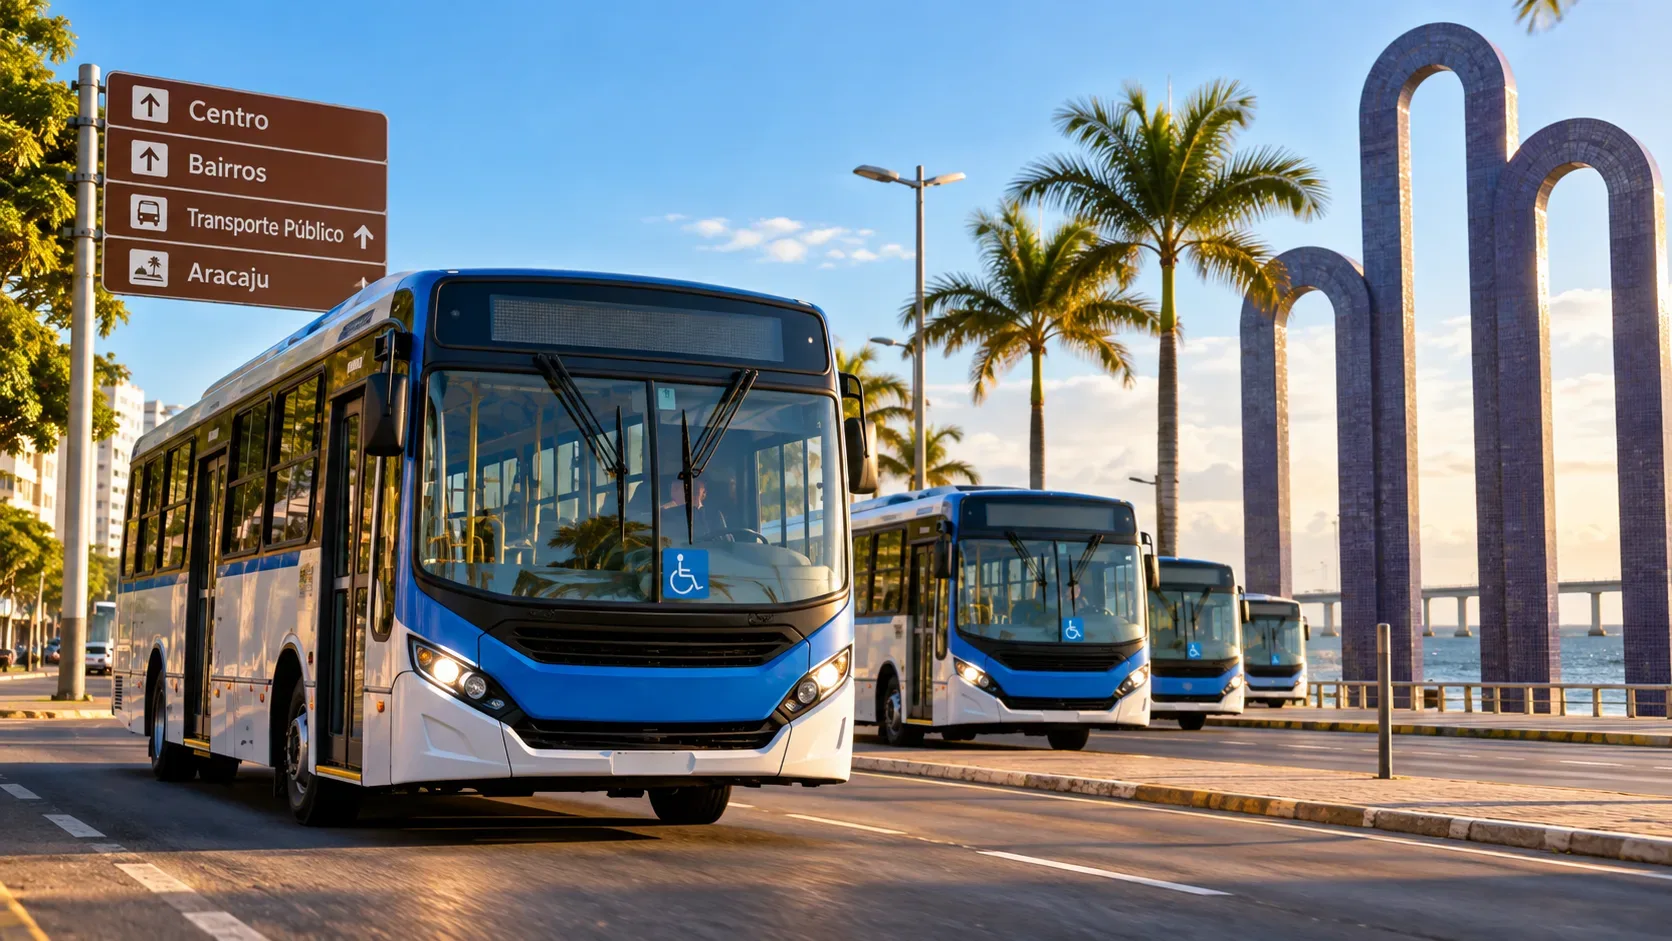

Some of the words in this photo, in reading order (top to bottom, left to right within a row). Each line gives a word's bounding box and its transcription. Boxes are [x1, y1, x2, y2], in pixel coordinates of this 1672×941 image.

[189, 99, 269, 131] Centro
[189, 153, 267, 183] Bairros
[187, 207, 279, 237] Transporte
[284, 218, 344, 243] Público
[187, 262, 269, 293] Aracaju
